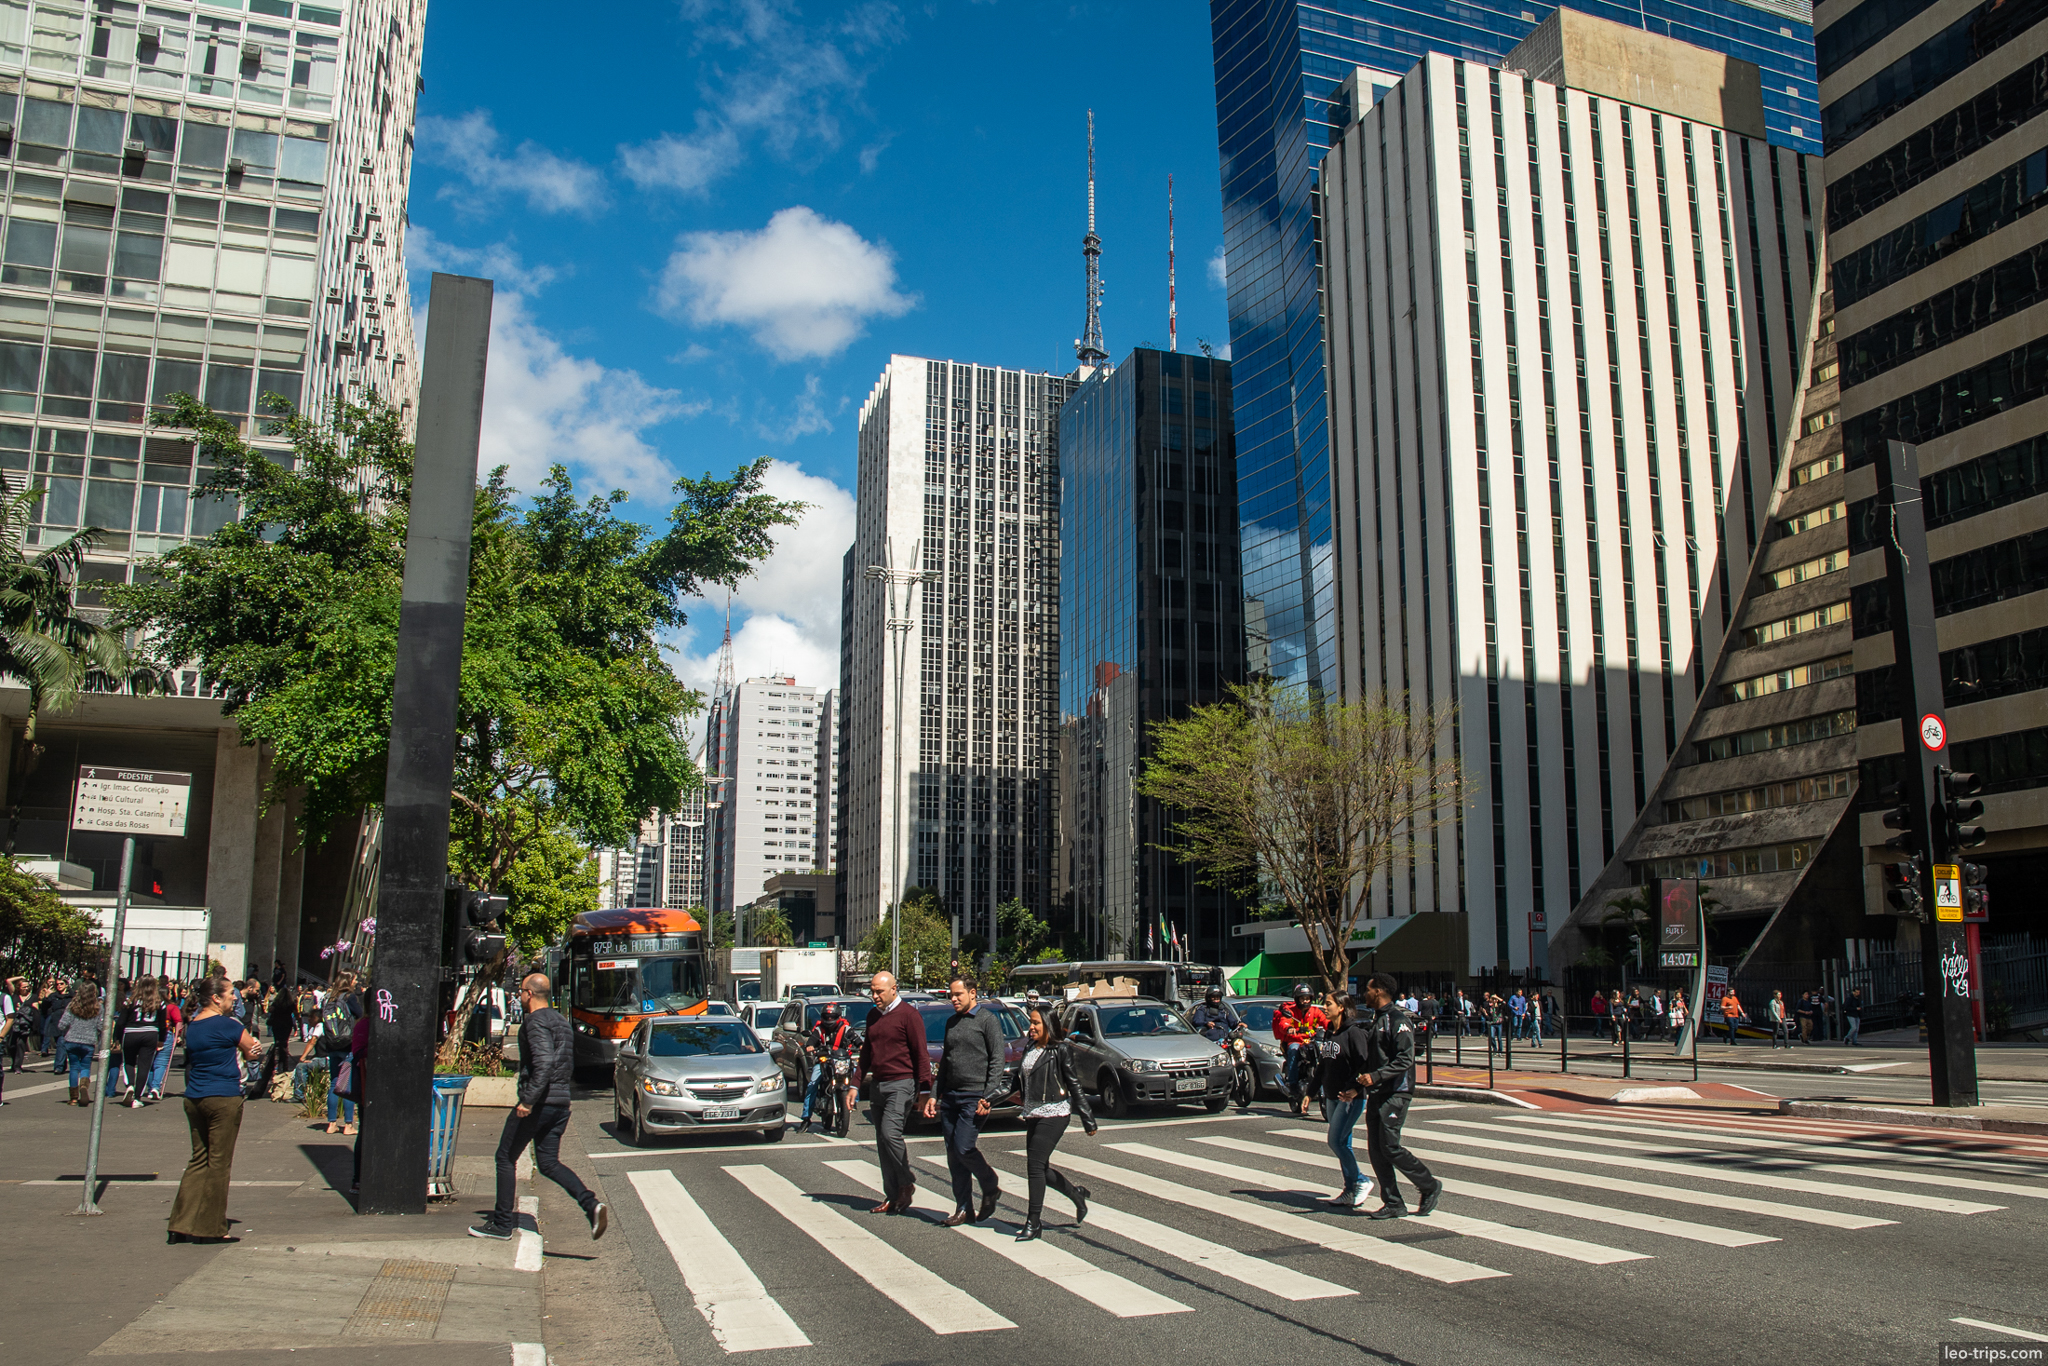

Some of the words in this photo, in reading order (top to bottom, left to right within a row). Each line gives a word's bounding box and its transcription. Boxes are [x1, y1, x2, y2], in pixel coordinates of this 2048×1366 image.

[117, 772, 154, 782] PEDESTRE
[100, 783, 112, 791] Igr.
[133, 785, 169, 794] Conceição
[115, 796, 143, 804] Cultural
[97, 807, 117, 816] Hosp.
[119, 808, 132, 816] Sta.
[134, 809, 165, 818] Catarina
[128, 821, 149, 829] Rosas
[593, 941, 612, 954] 875P
[615, 942, 627, 953] via
[1661, 953, 1692, 966] 14:07
